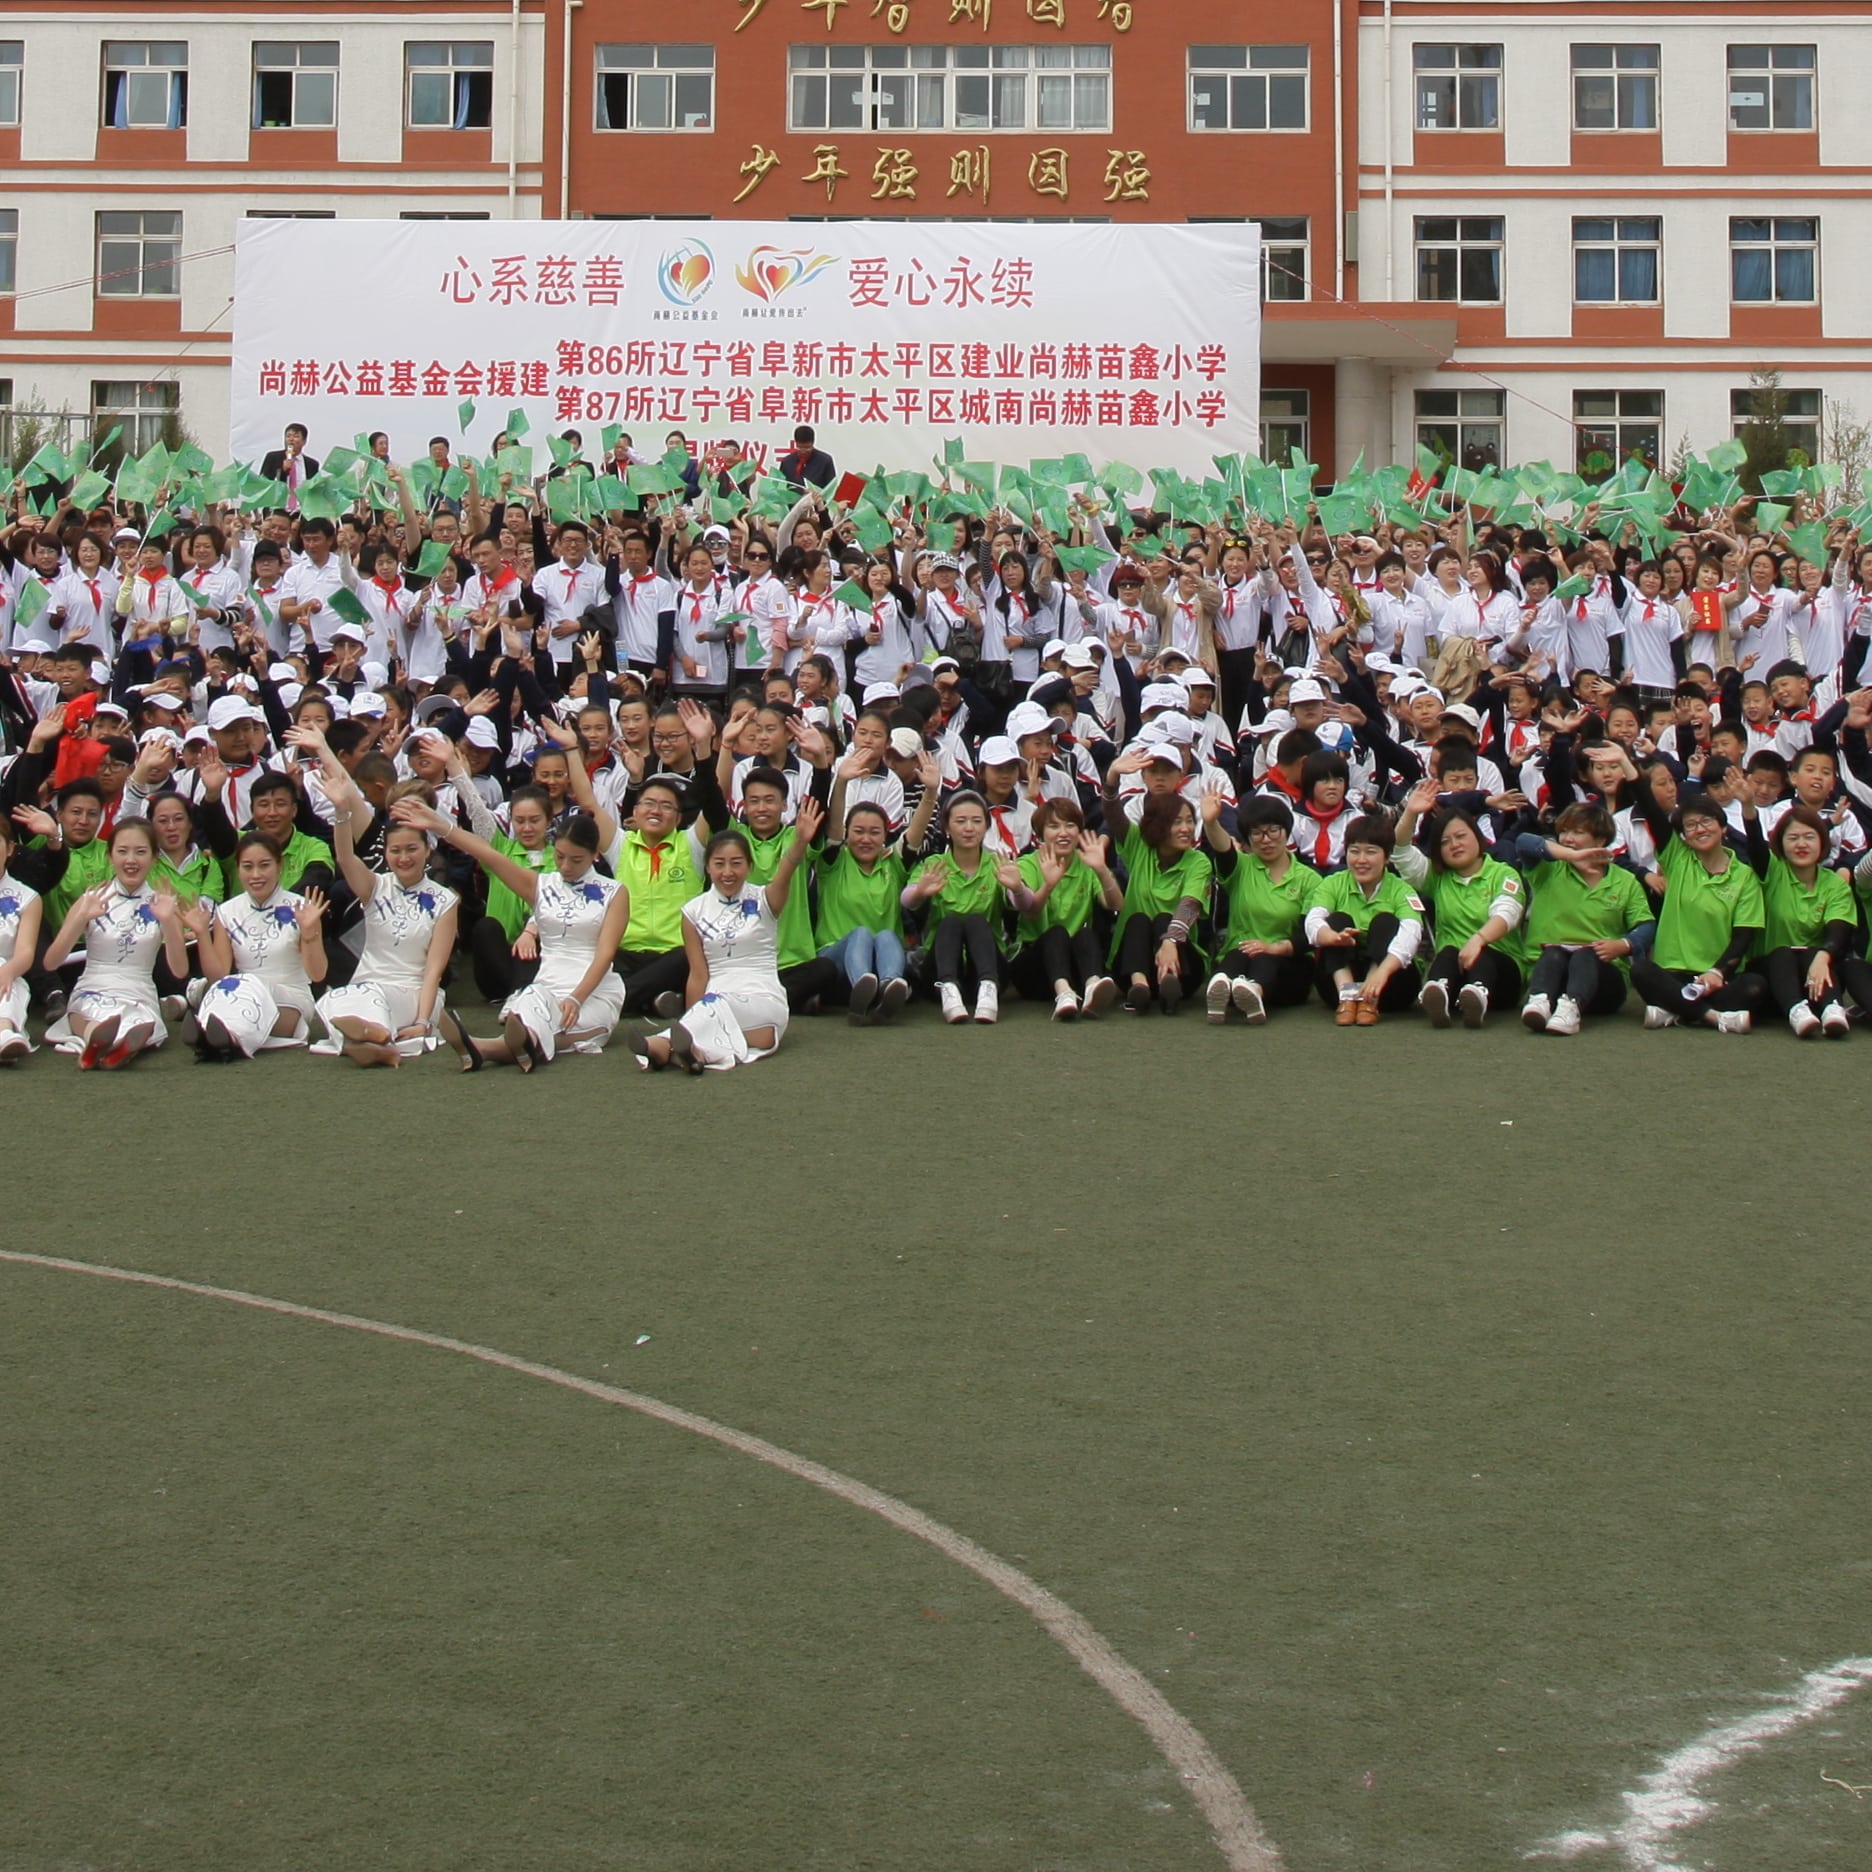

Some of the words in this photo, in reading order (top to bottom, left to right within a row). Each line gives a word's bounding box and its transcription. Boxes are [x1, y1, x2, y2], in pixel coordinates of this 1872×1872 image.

[733, 144, 1151, 204] 少年强则国强
[440, 255, 625, 306] 心系慈善
[849, 256, 1034, 308] 爱心永续
[259, 360, 550, 397] 尚赫公益基金会援建
[555, 340, 1227, 382] 第86所辽宁省阜新市太平区建业尚赫苗鑫小学
[554, 386, 1226, 428] 第87所辽宁省阜新市太平区城南尚赫苗鑫小学
